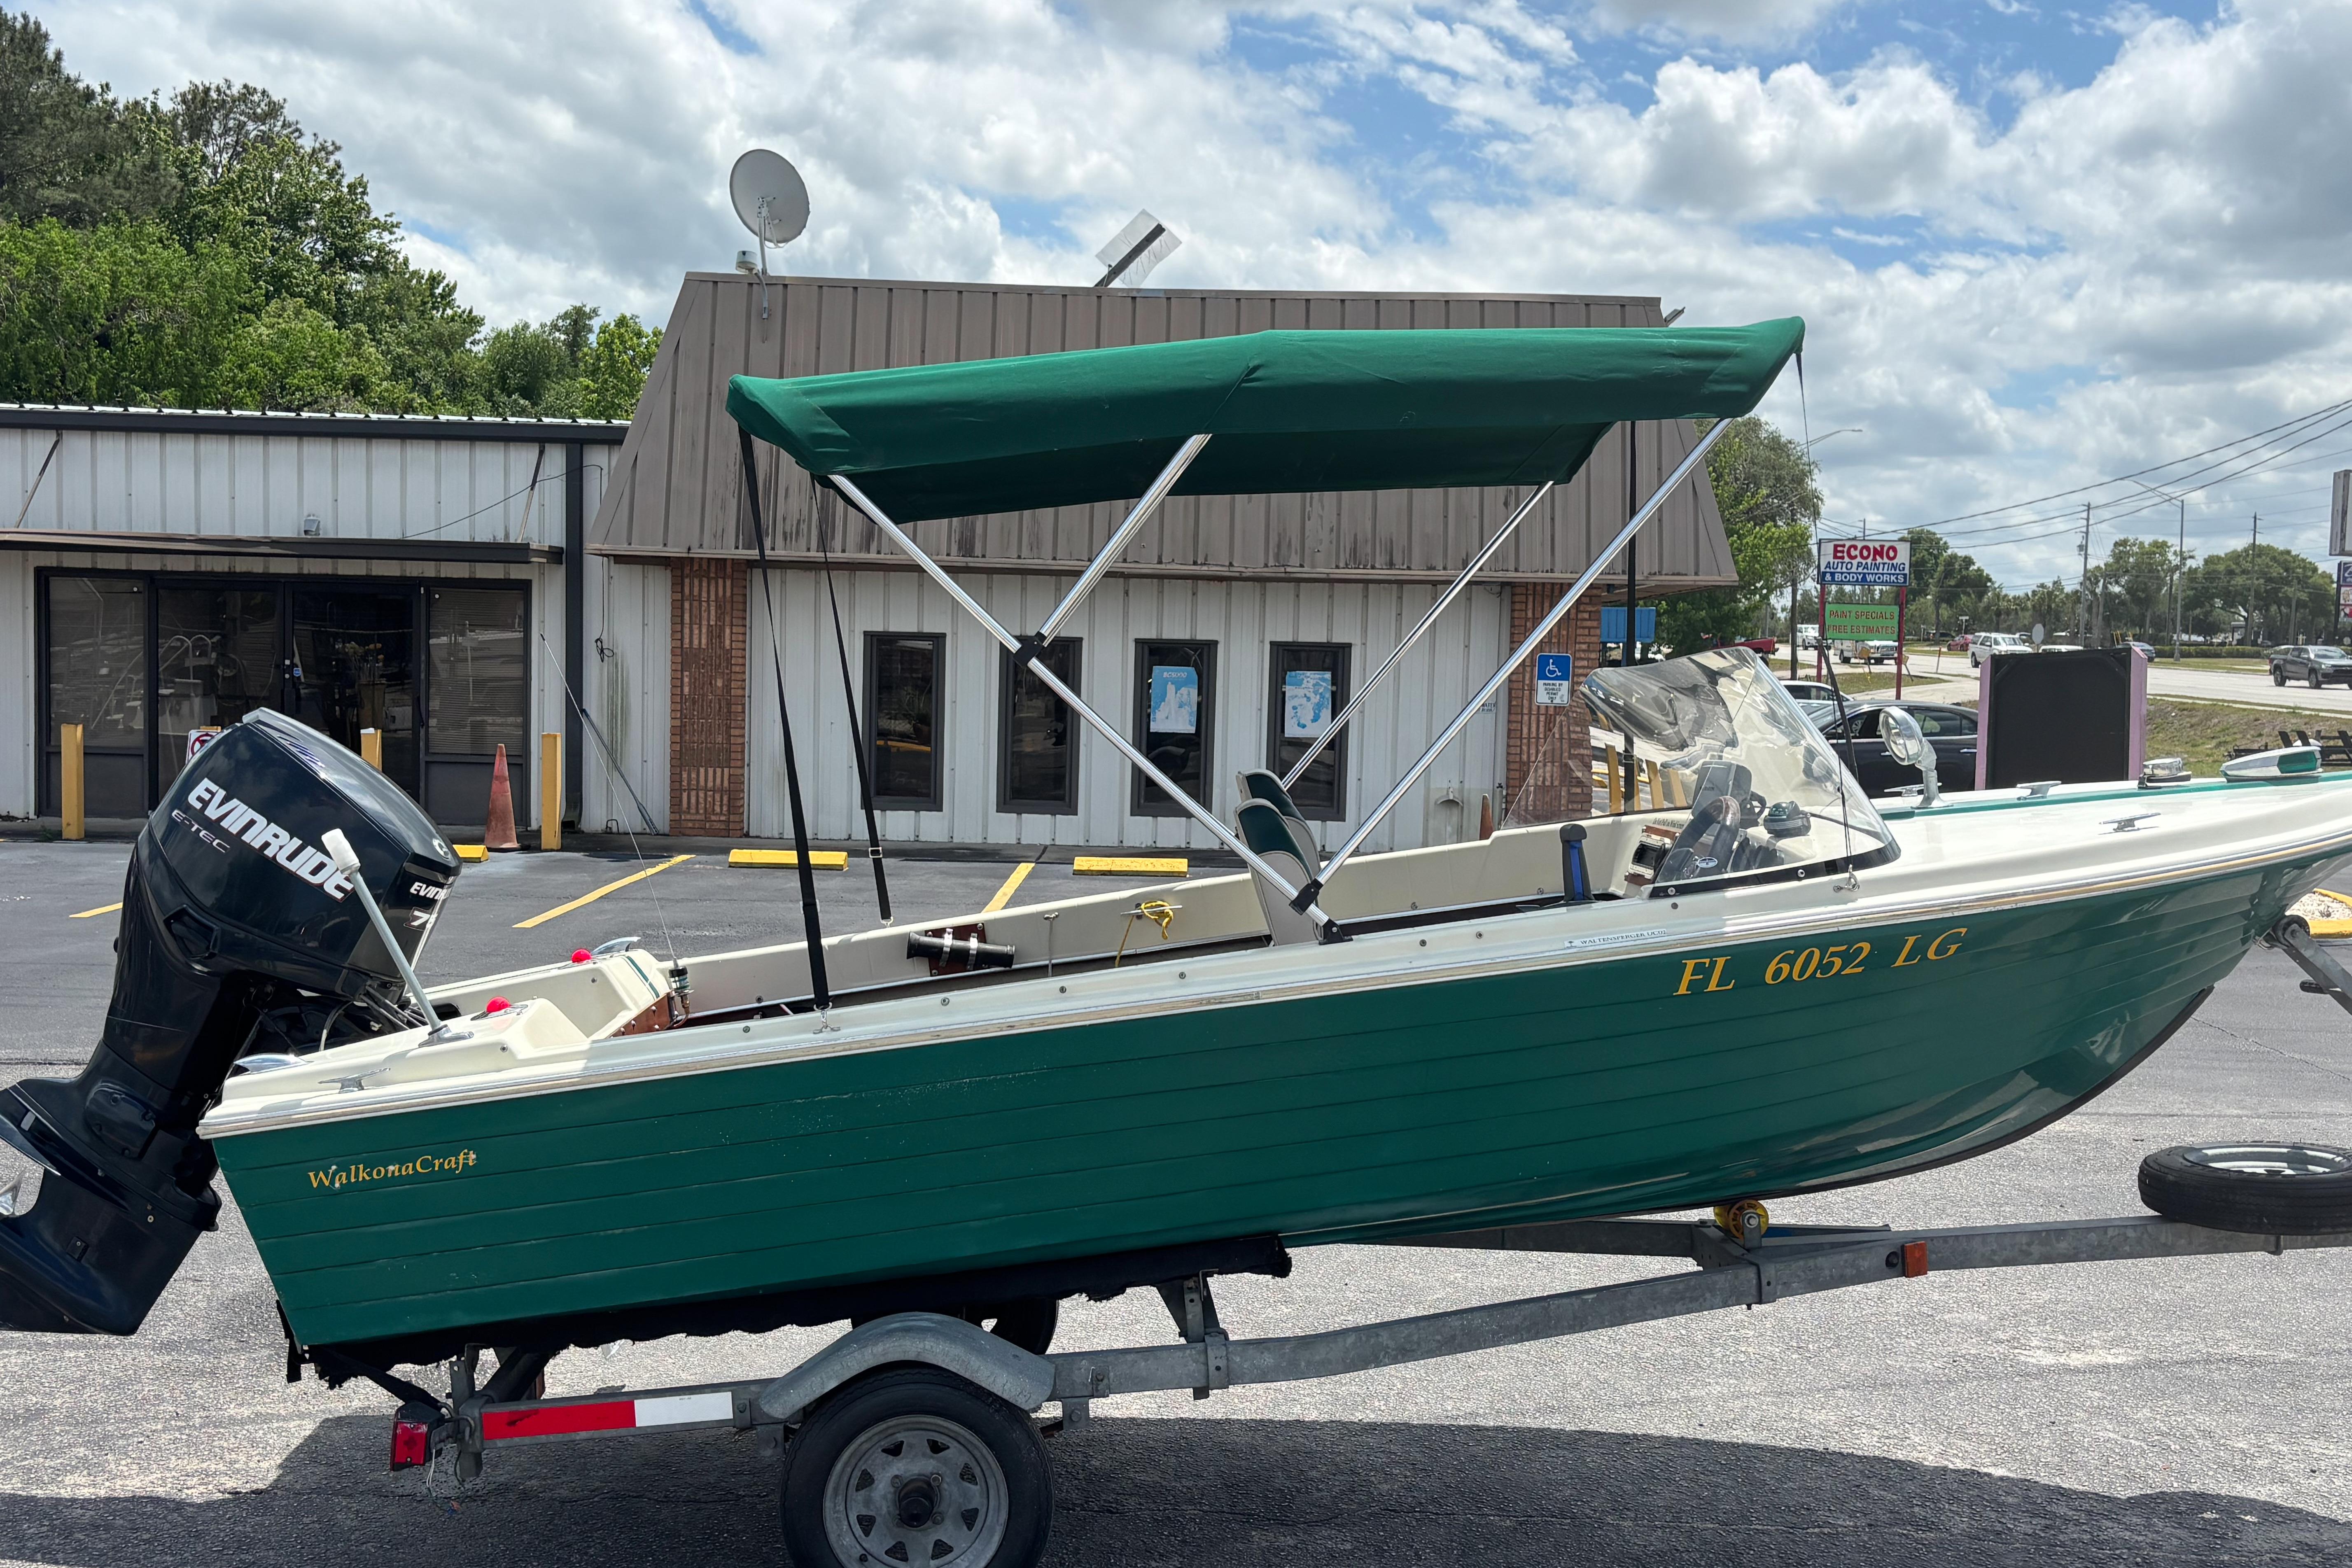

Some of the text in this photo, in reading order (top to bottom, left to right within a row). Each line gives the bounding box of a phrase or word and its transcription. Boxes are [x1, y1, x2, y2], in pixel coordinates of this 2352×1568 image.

[1833, 544, 1898, 561] ECONO
[1824, 561, 1906, 572] AUTO PAINTING
[1825, 572, 1904, 583] & BODY WORKS
[1829, 610, 1895, 620] PAINT SPECIALS
[1827, 624, 1895, 635] FREE ESTIMATES
[172, 809, 231, 853] E-TEC
[188, 777, 355, 900] EVINRUDE
[1580, 933, 1645, 945] WALTENSPERGER
[1673, 927, 1967, 996] FL 6052 LG
[308, 1149, 477, 1189] WalkonaCraft
